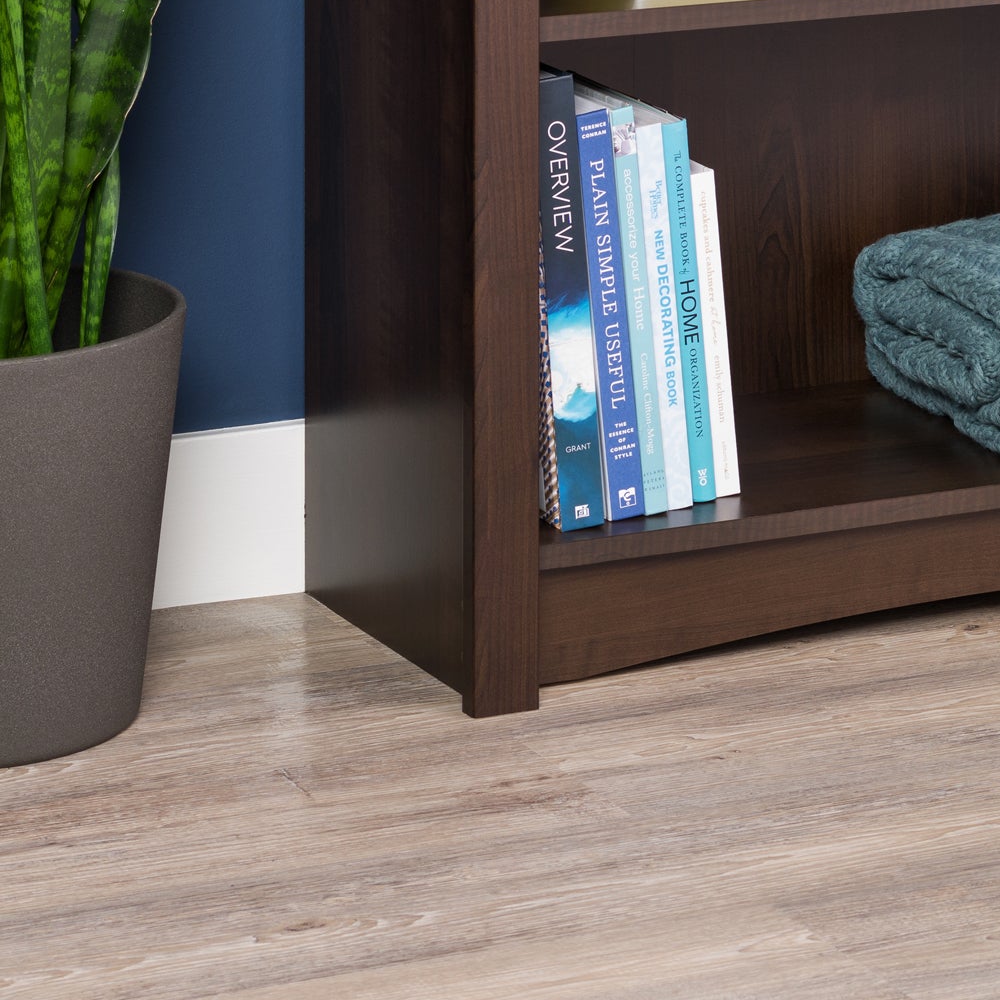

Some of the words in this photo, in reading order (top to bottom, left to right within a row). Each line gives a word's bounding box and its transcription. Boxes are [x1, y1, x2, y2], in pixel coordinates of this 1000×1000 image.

[580, 121, 607, 132] TERENCE
[581, 129, 607, 139] CONRAN
[547, 120, 574, 253] OVERVIEW
[589, 158, 610, 227] PLAIN
[675, 165, 687, 228] COMPLETE
[623, 168, 638, 249] accessorize
[654, 230, 666, 260] NEW
[680, 231, 690, 266] BOOK
[704, 234, 712, 255] and
[596, 234, 618, 316] SIMPLE
[627, 252, 640, 281] your
[633, 286, 645, 331] Home
[656, 264, 677, 368] DECORATING
[680, 278, 700, 346] HOME
[604, 322, 626, 409] USEFUL
[664, 371, 679, 407] BOOK
[689, 348, 703, 439] ORGANIZATION
[608, 428, 634, 438] ESSENCE
[614, 421, 627, 429] THE
[565, 442, 592, 453] GRANT
[609, 443, 636, 453] CONRAN
[614, 451, 633, 460] STYLE
